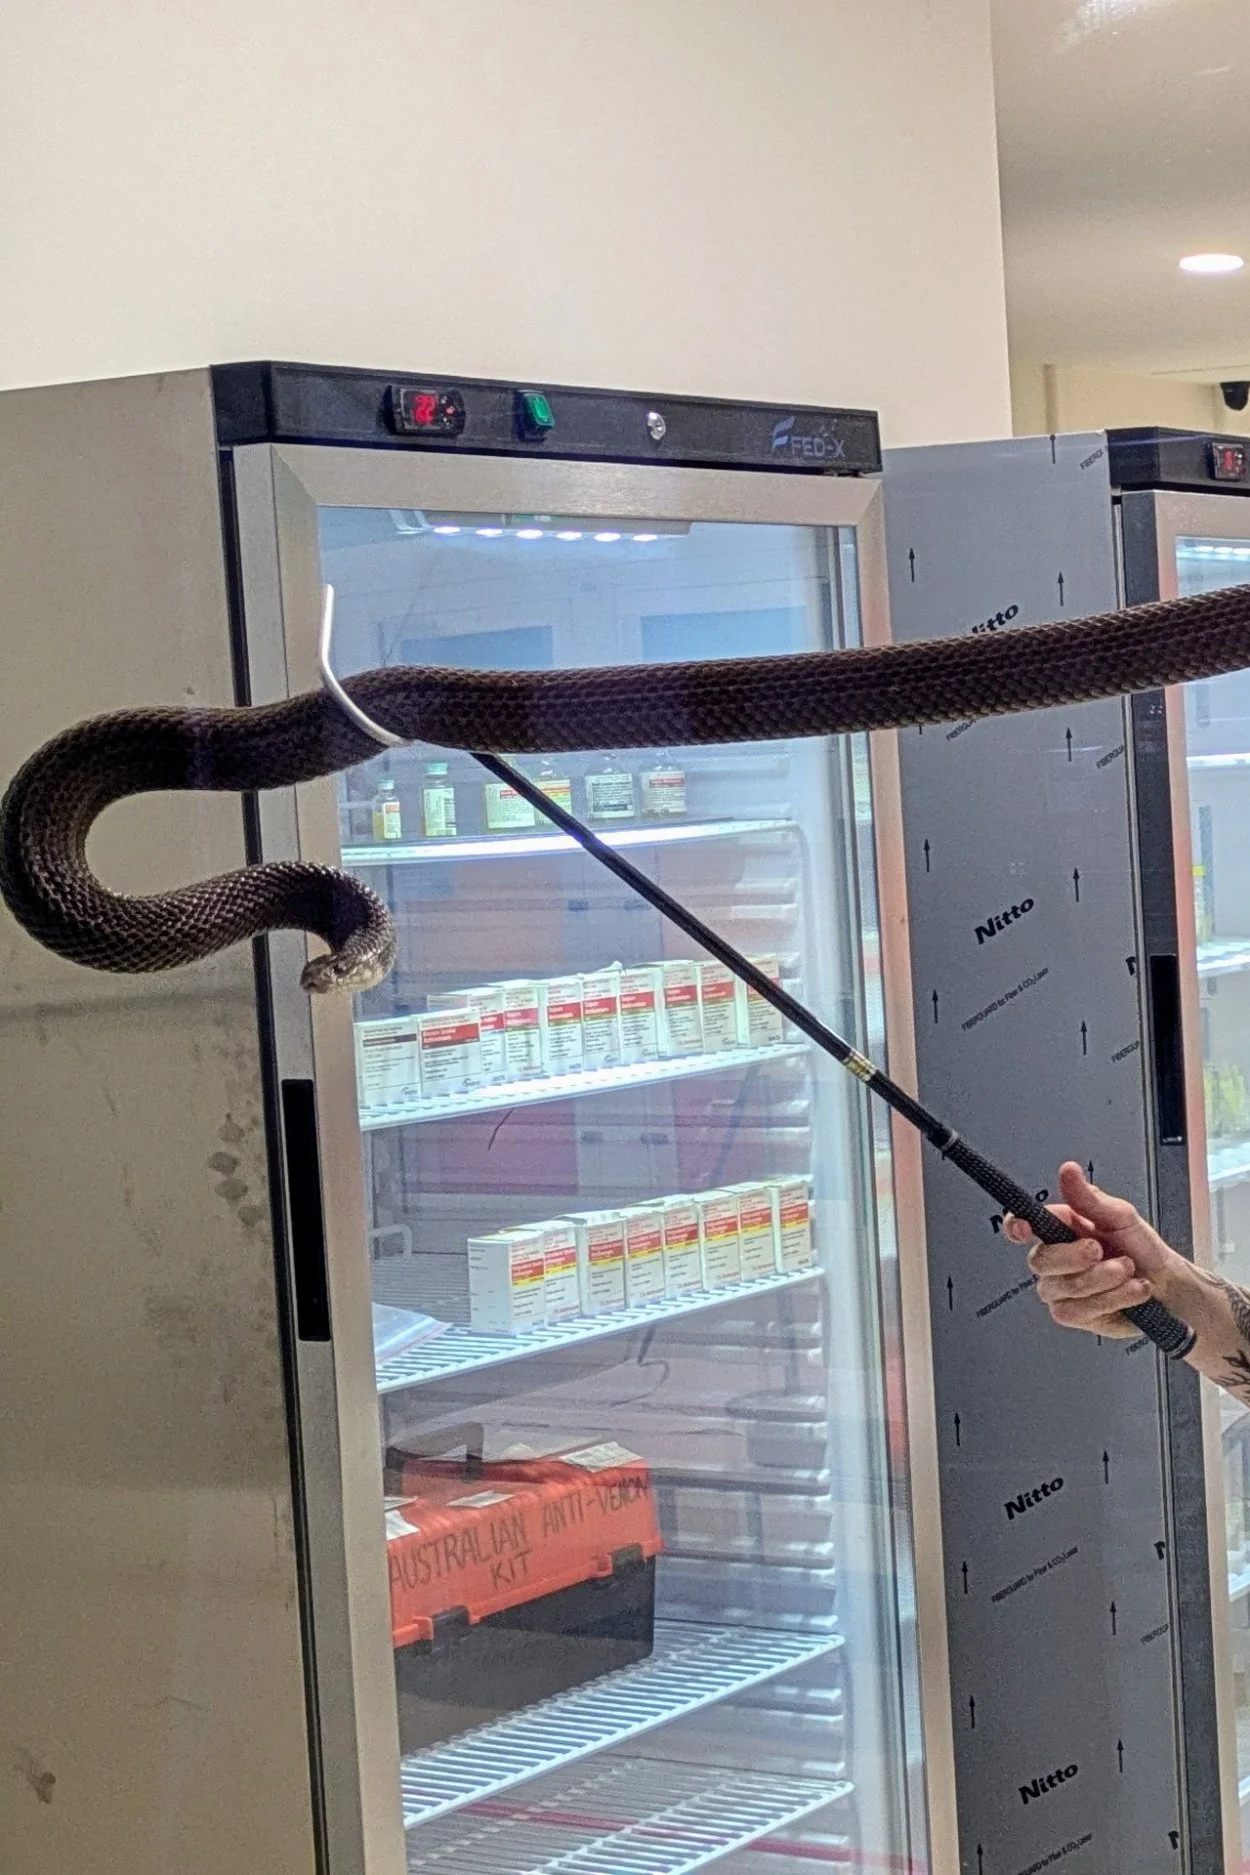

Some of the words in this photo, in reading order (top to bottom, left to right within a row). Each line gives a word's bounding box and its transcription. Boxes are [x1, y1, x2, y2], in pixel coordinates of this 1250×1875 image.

[791, 436, 846, 458] FED-X
[972, 604, 1019, 633] itto
[974, 897, 1035, 945] Nitto
[1003, 1477, 1064, 1520] Nitto
[389, 1511, 528, 1594] AUSTRALIAN
[490, 1549, 532, 1591] KIT
[1018, 1764, 1079, 1804] Nitto
